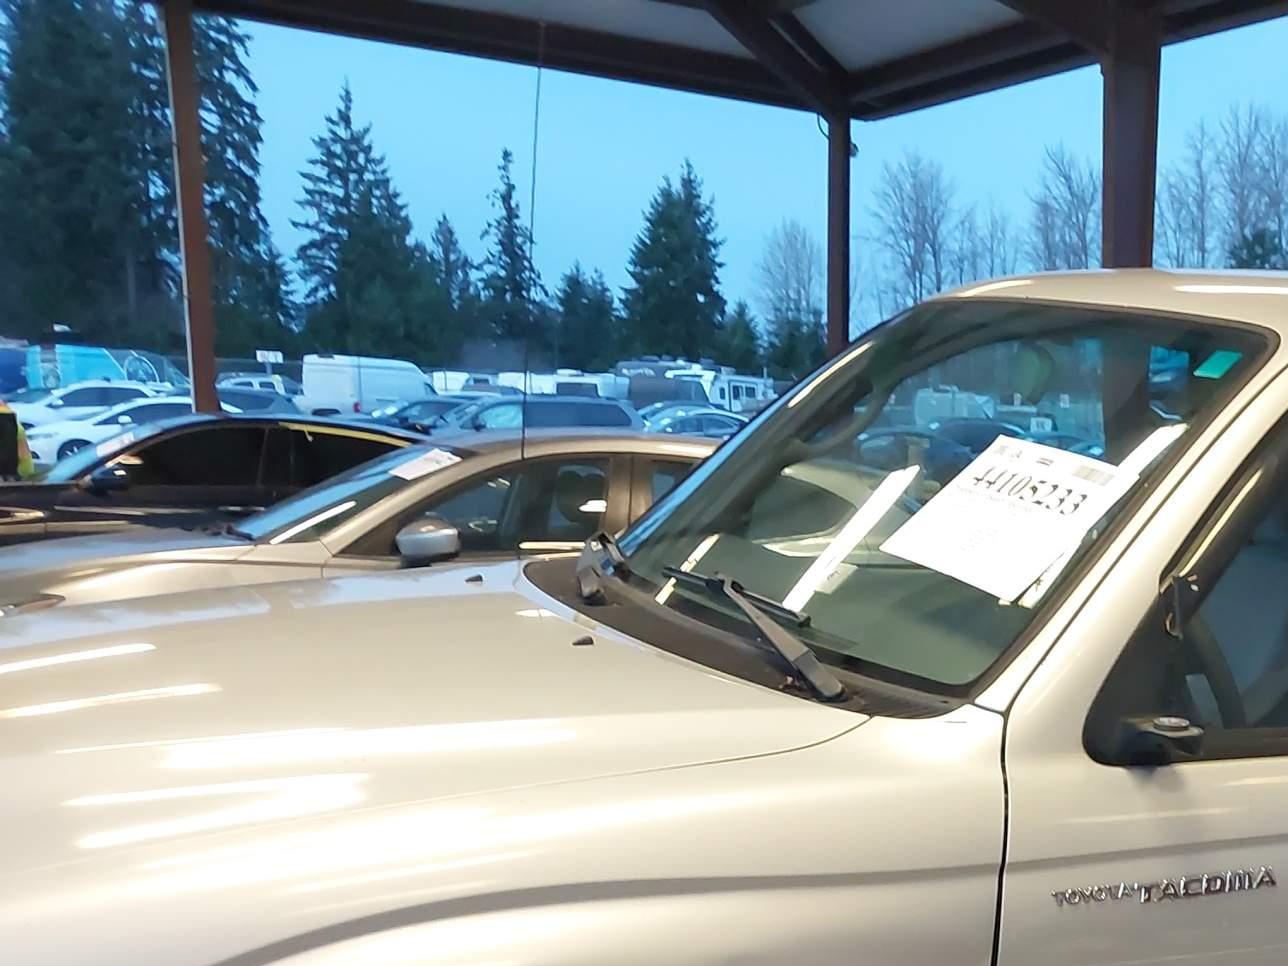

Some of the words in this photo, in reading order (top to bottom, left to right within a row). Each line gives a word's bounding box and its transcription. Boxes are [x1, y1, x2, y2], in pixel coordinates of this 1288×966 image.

[973, 466, 1088, 515] 44105233
[1052, 882, 1133, 907] TOYOTA
[1134, 866, 1277, 904] TACOMA
